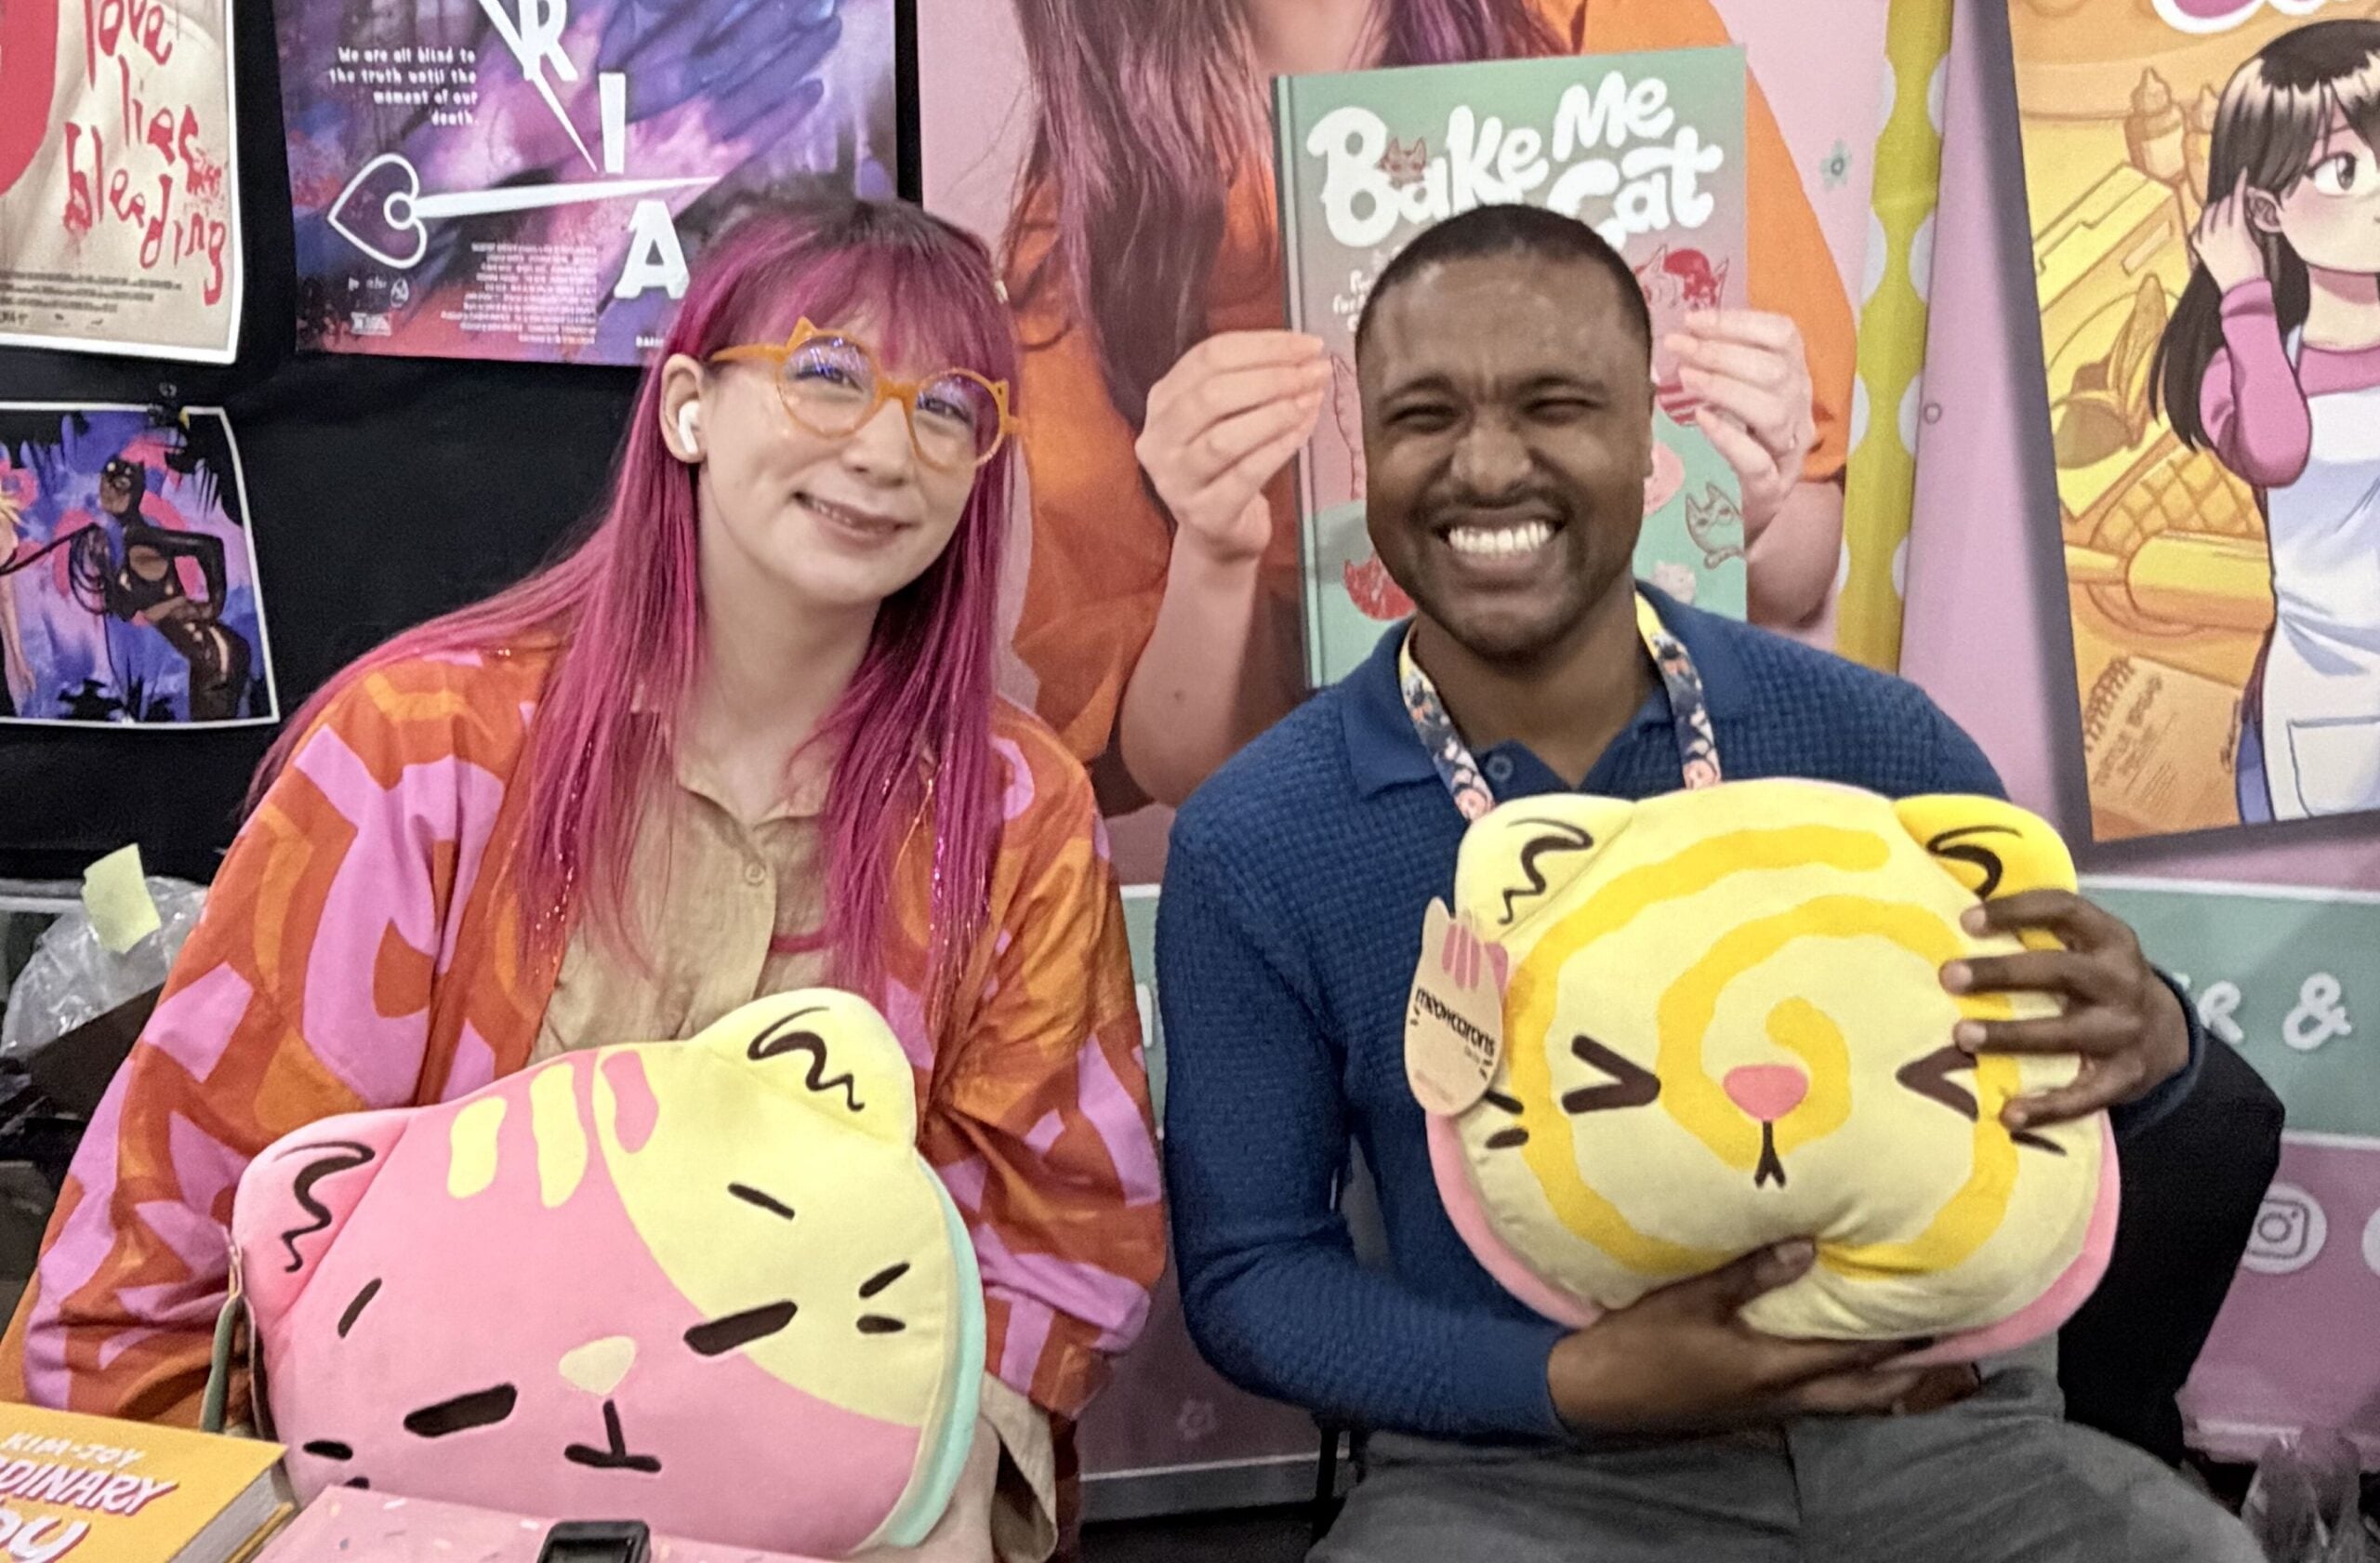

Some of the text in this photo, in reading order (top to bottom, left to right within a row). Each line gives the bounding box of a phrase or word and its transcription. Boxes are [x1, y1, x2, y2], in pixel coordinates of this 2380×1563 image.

[329, 68, 476, 85] the truth until the
[338, 46, 476, 63] We are all blind to
[374, 88, 478, 104] moment of our
[1306, 71, 1674, 247] Bake Me
[1547, 126, 1725, 249] Cat
[2282, 972, 2352, 1051] &
[2, 1432, 146, 1469] KIM-JOY
[0, 1454, 180, 1517] DINARY
